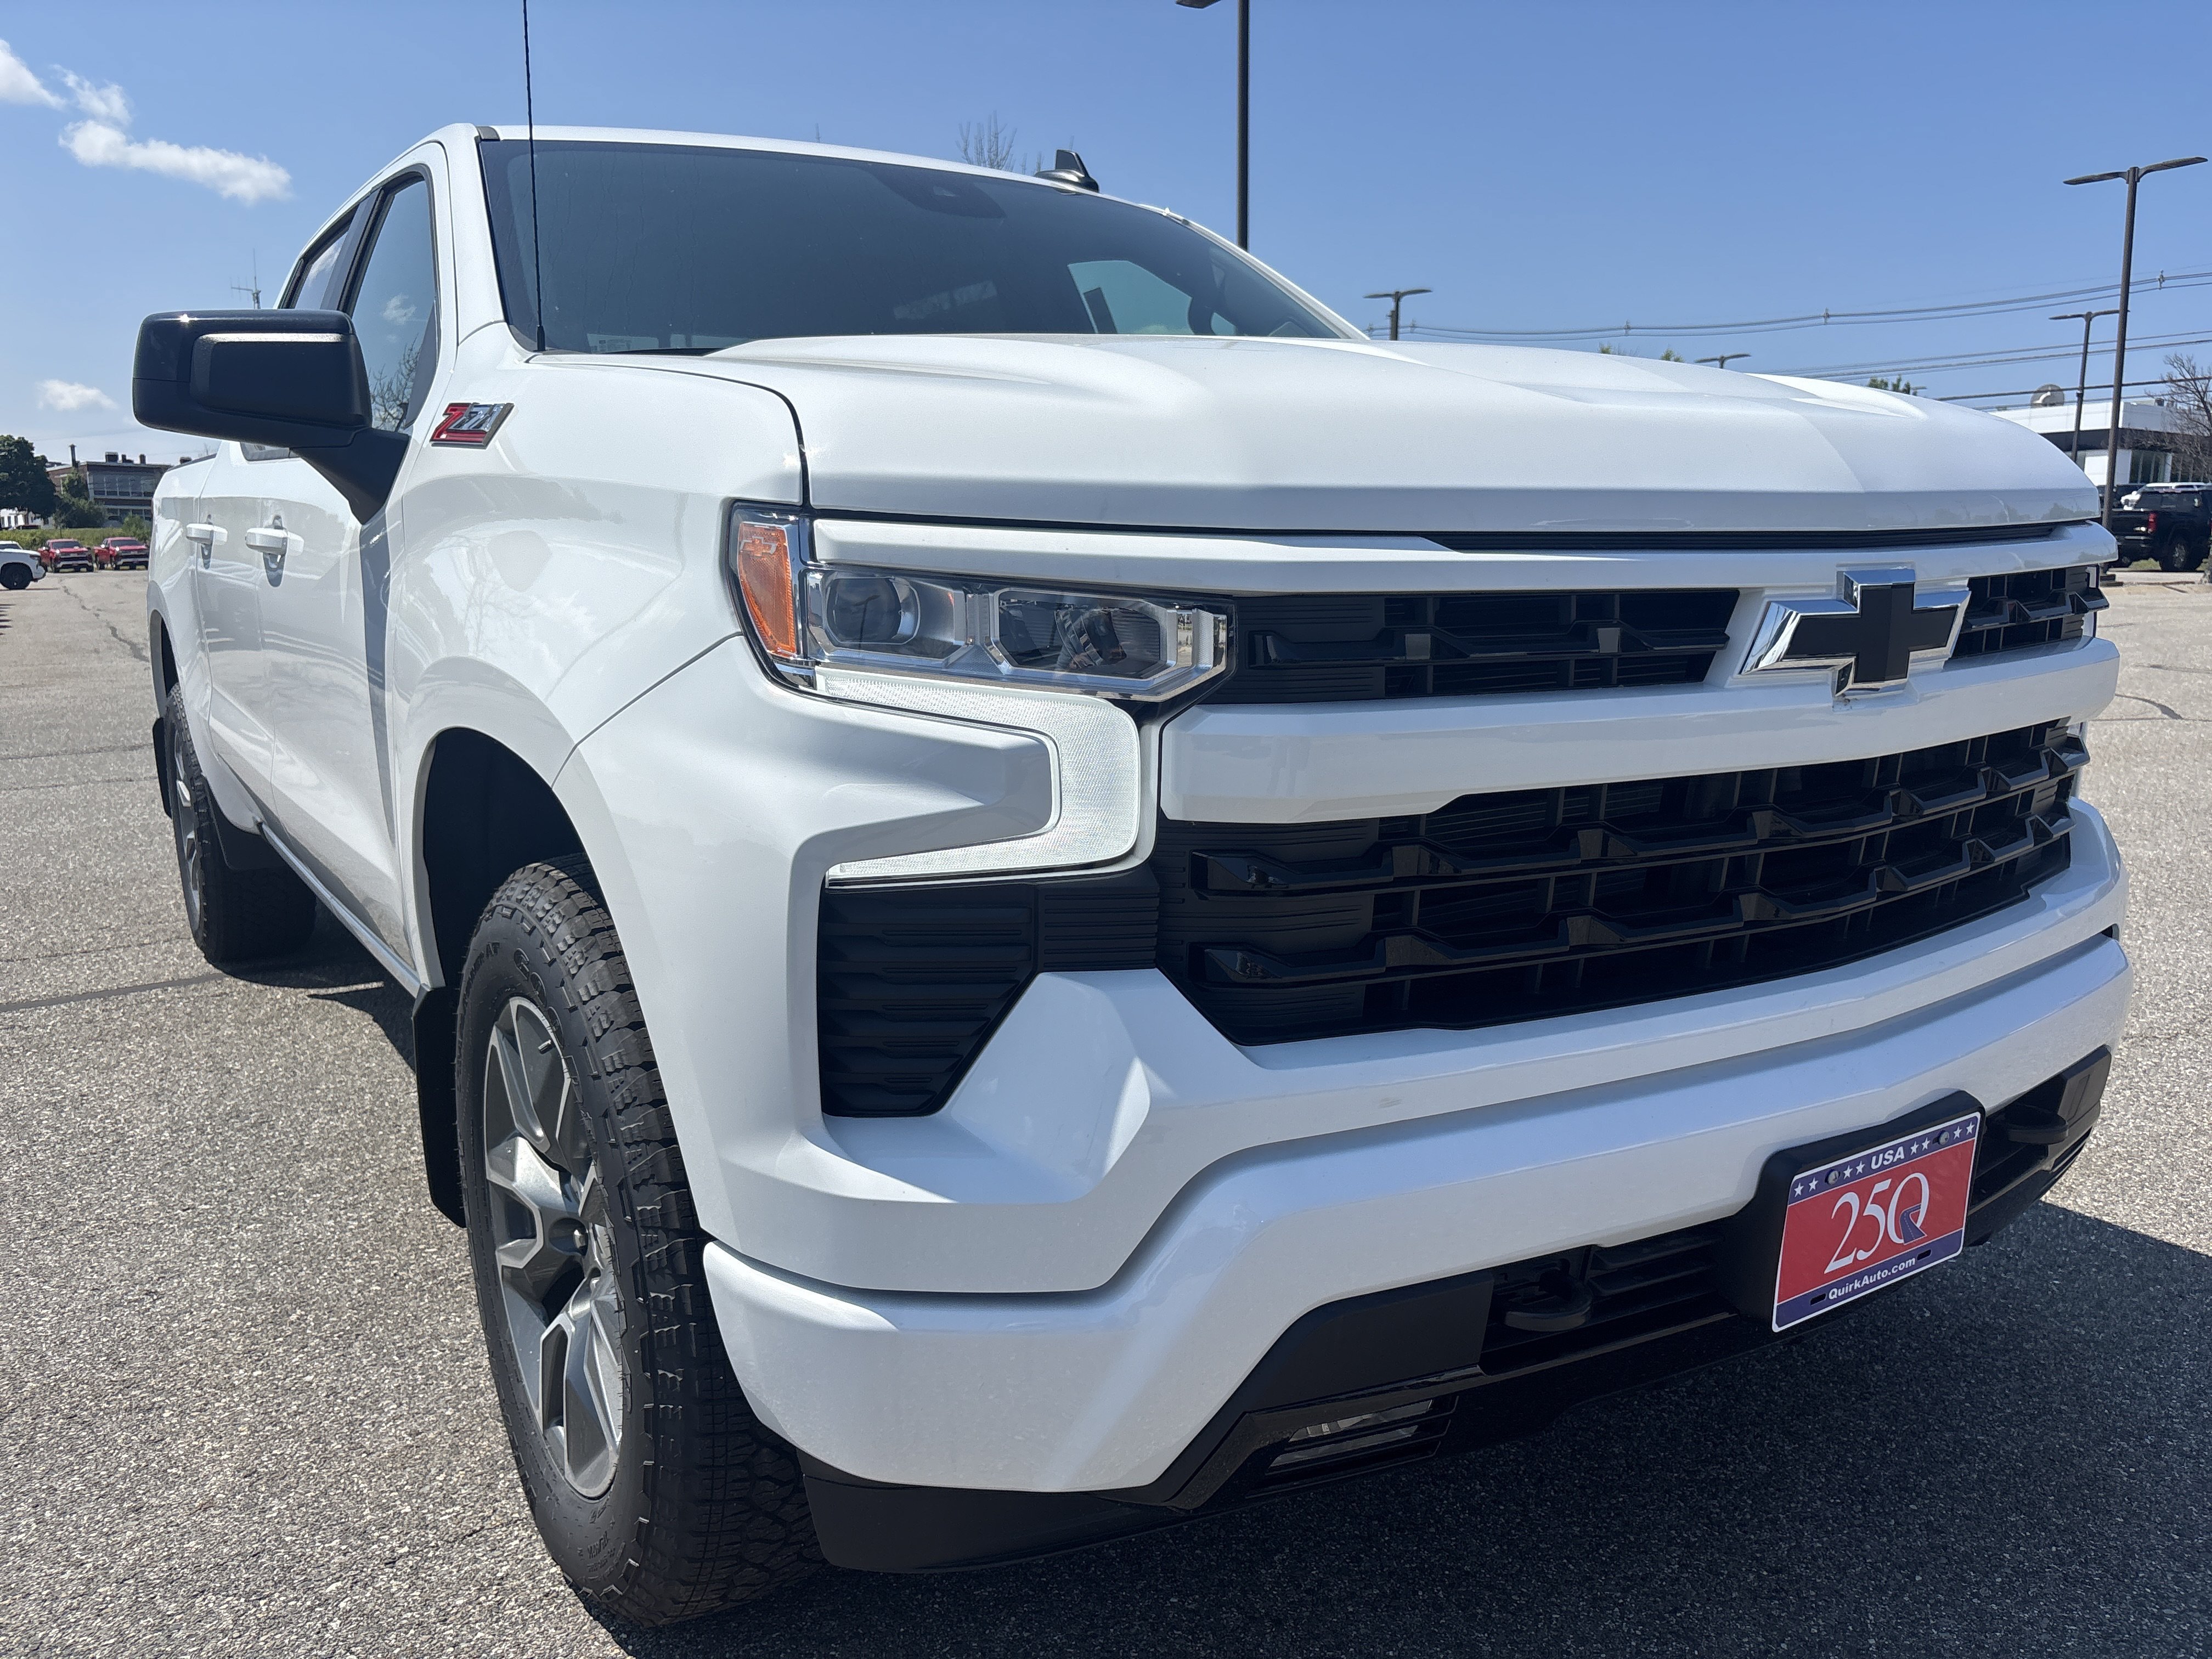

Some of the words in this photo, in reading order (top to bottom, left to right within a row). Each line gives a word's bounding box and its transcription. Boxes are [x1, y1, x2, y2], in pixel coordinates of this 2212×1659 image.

[430, 403, 510, 445] Z71
[1871, 1146, 1905, 1170] USA
[1829, 1257, 1916, 1300] QuirkAuto.com
